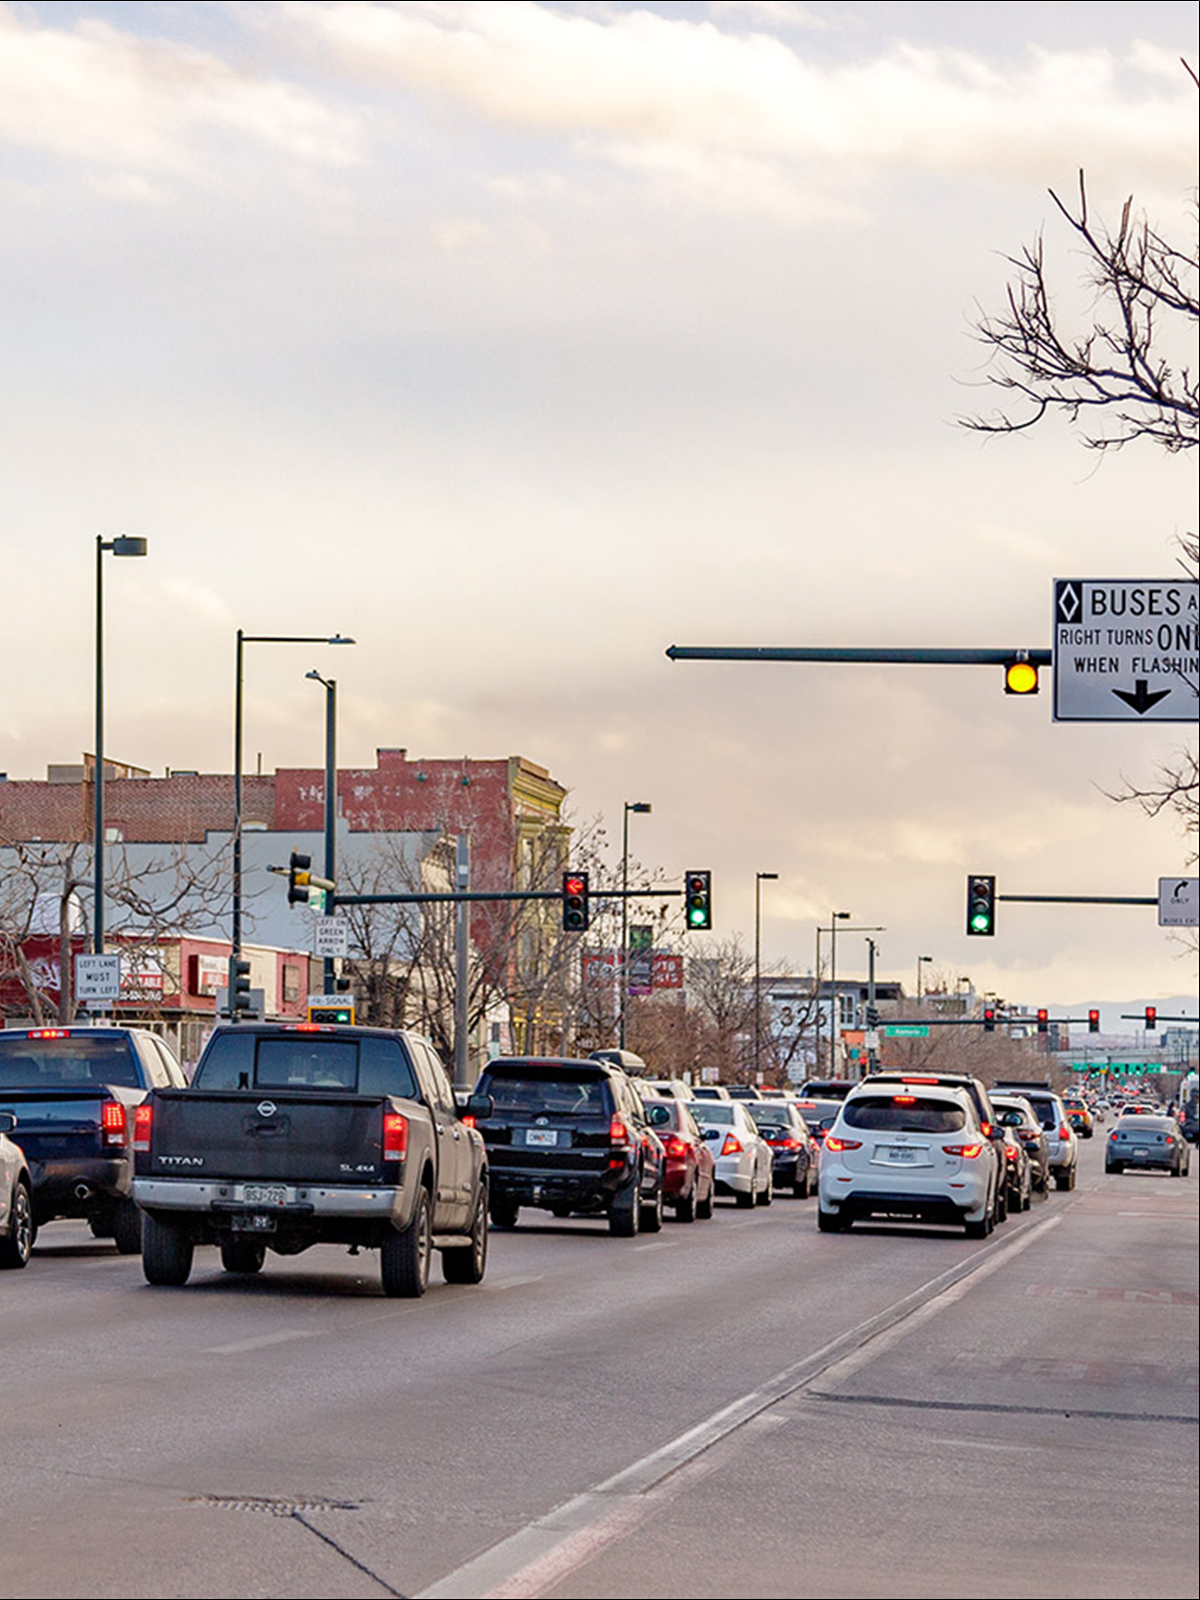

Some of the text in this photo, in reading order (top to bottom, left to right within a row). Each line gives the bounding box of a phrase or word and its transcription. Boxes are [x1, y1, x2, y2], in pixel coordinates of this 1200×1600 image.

[1091, 588, 1181, 616] BUSES
[1059, 628, 1102, 645] RIGHT
[1106, 628, 1154, 645] TURNS
[1073, 657, 1199, 674] WHEN FLASHIN
[320, 946, 341, 954] ONLY
[79, 960, 117, 968] LEFT LANE
[86, 972, 110, 981] MUST
[79, 986, 118, 994] TURN LEFT
[325, 997, 351, 1005] SIGNAL
[158, 1156, 204, 1166] TITAN
[339, 1163, 353, 1172] SL
